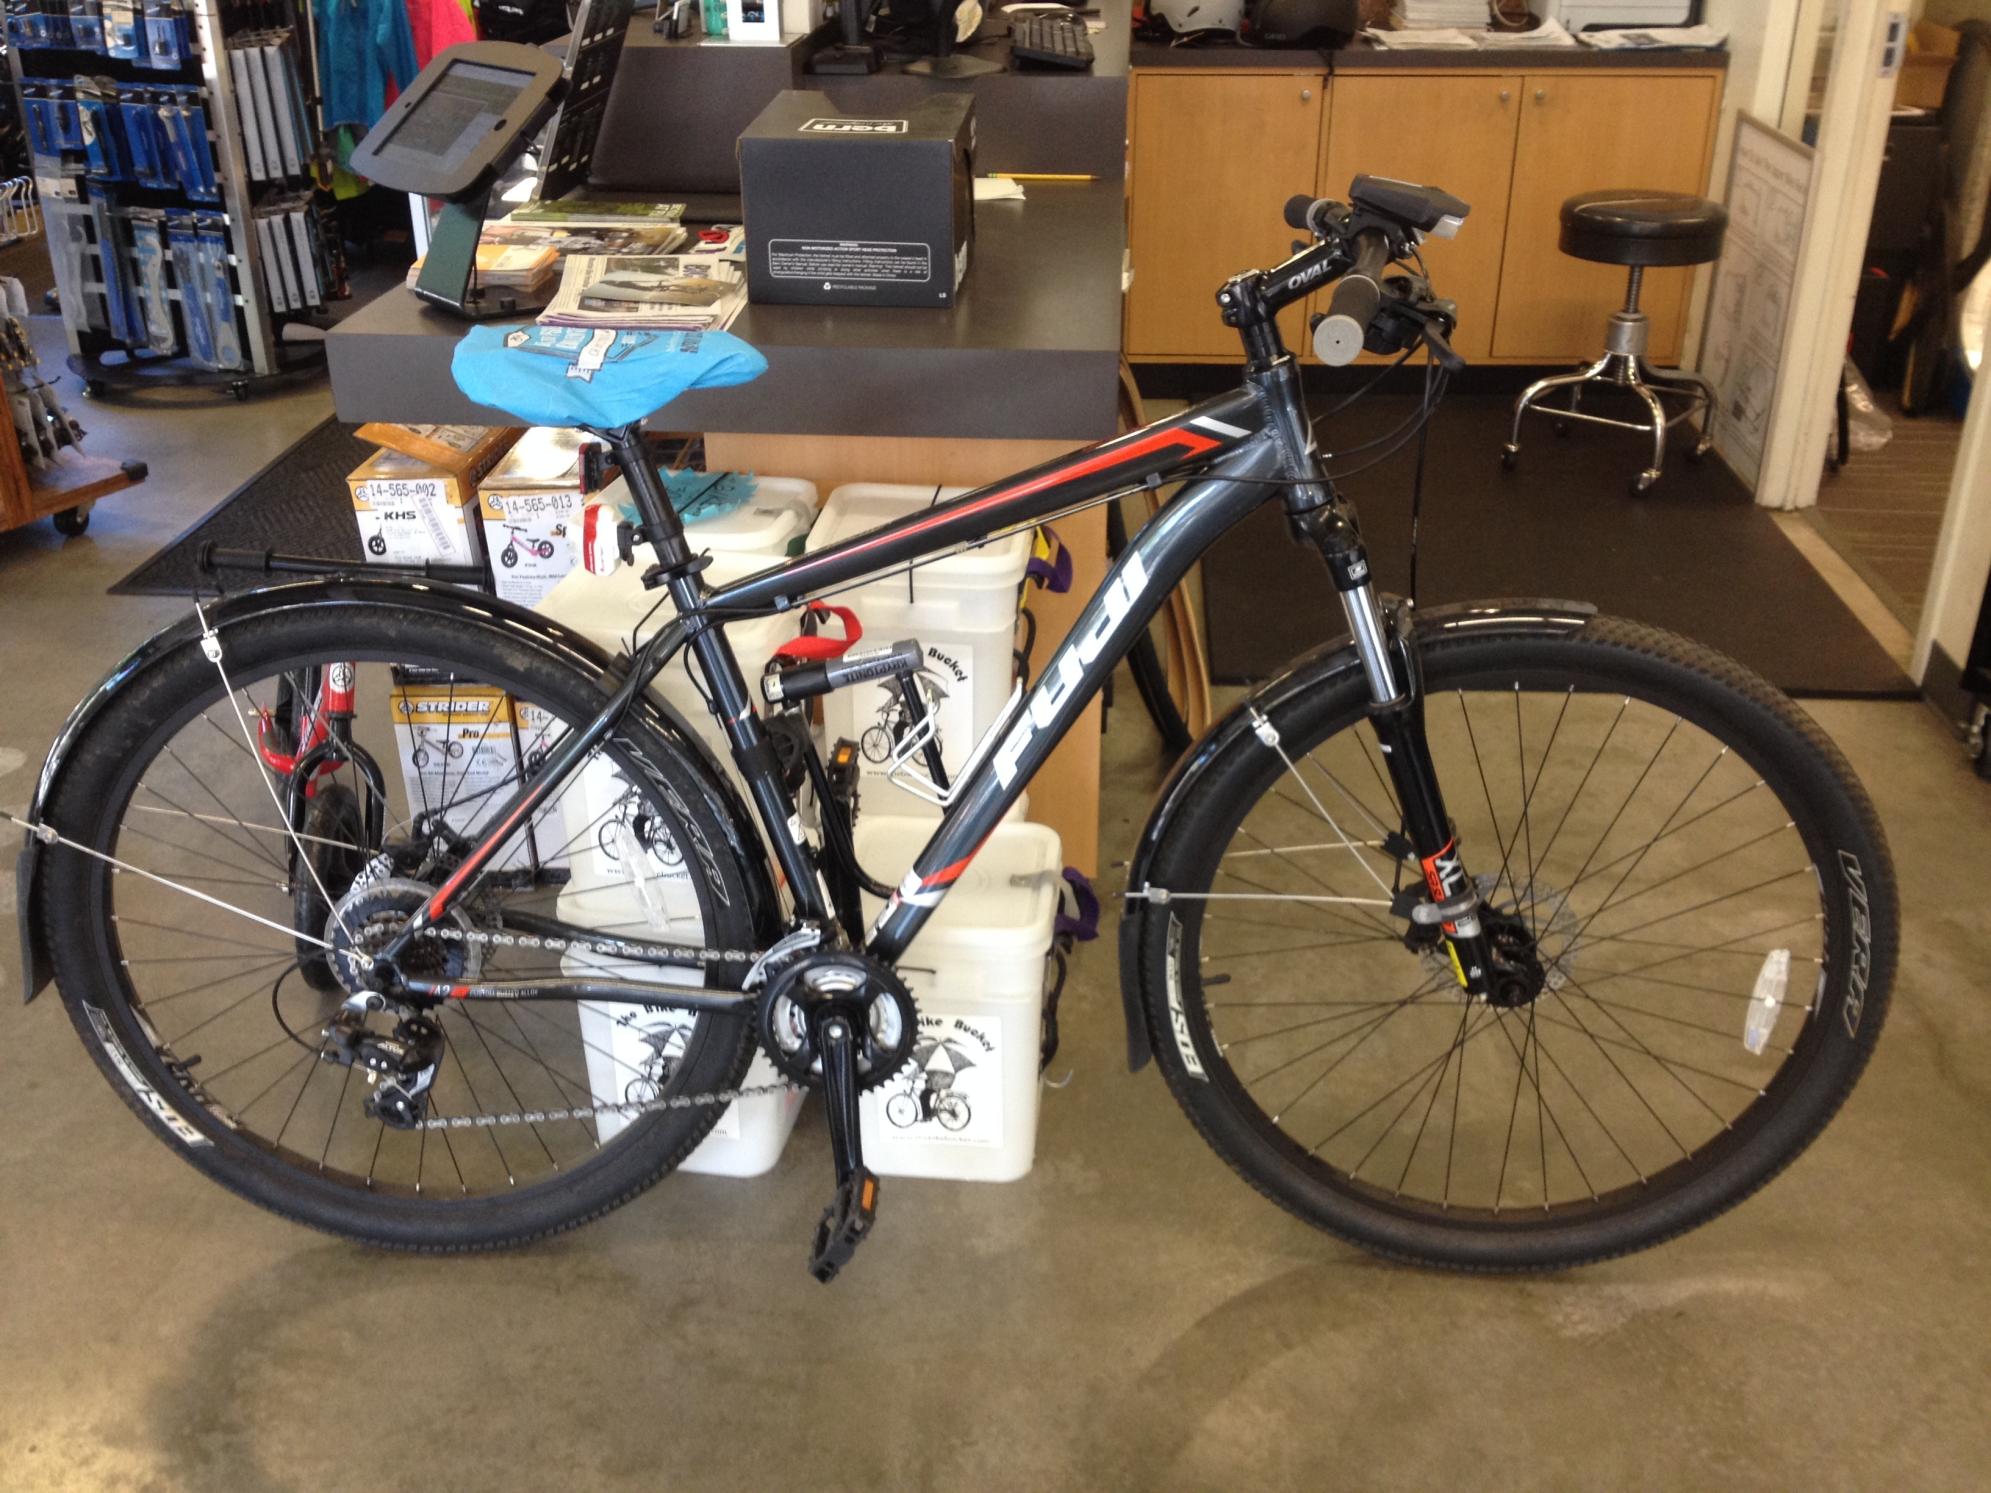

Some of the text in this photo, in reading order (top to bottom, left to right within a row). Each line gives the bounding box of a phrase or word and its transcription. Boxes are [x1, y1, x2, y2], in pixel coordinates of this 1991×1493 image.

[812, 123, 898, 133] bern
[1287, 258, 1333, 290] OVAL
[505, 494, 573, 515] 14-565-013
[384, 510, 417, 521] KHS
[928, 646, 969, 683] Bucket
[992, 550, 1149, 791] FUJI
[416, 701, 490, 713] STRIDER
[462, 727, 480, 739] Pro
[917, 1015, 996, 1053] ike Bucket
